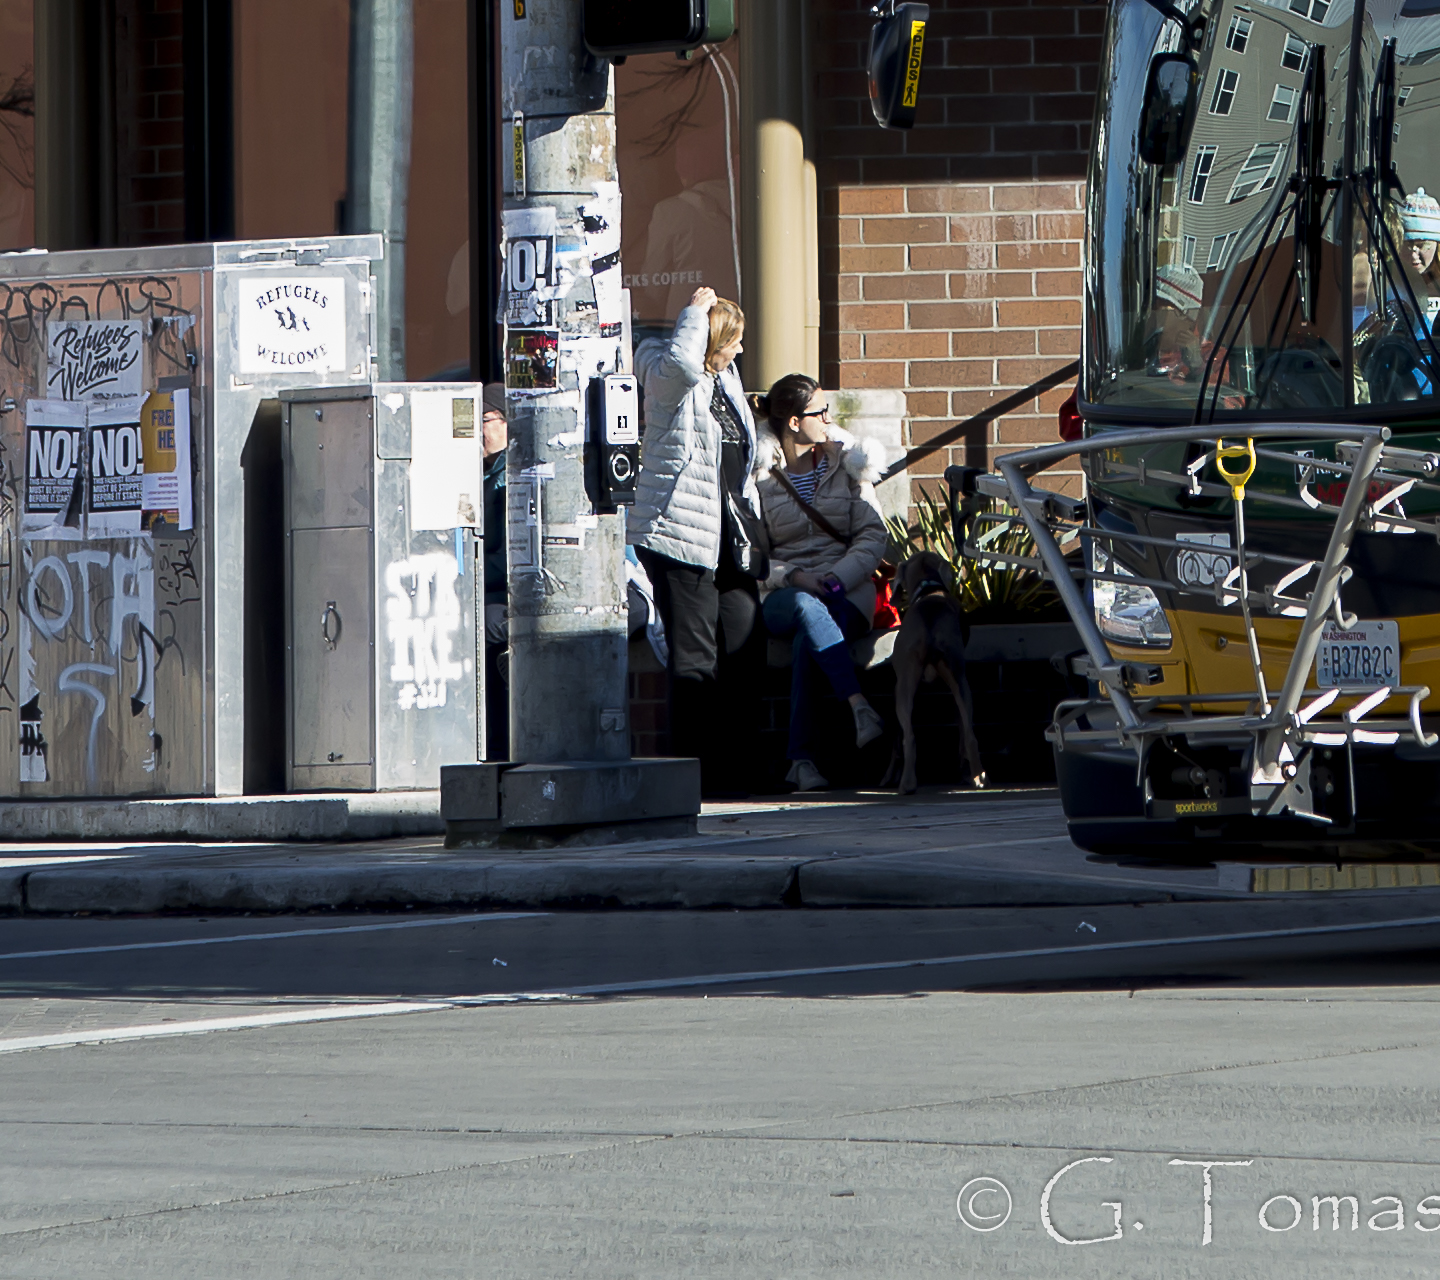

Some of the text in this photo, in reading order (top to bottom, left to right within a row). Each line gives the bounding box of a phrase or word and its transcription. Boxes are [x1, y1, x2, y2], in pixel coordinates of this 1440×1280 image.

[652, 269, 704, 286] COFFEE
[256, 284, 329, 310] REFUGEES
[53, 324, 140, 366] Refugees
[256, 343, 329, 366] WELCOME
[48, 350, 140, 401] Welcome
[30, 429, 80, 479] NO!
[92, 425, 145, 477] NO!
[1321, 631, 1367, 641] WASHINGTON
[1331, 645, 1393, 678] B3782C
